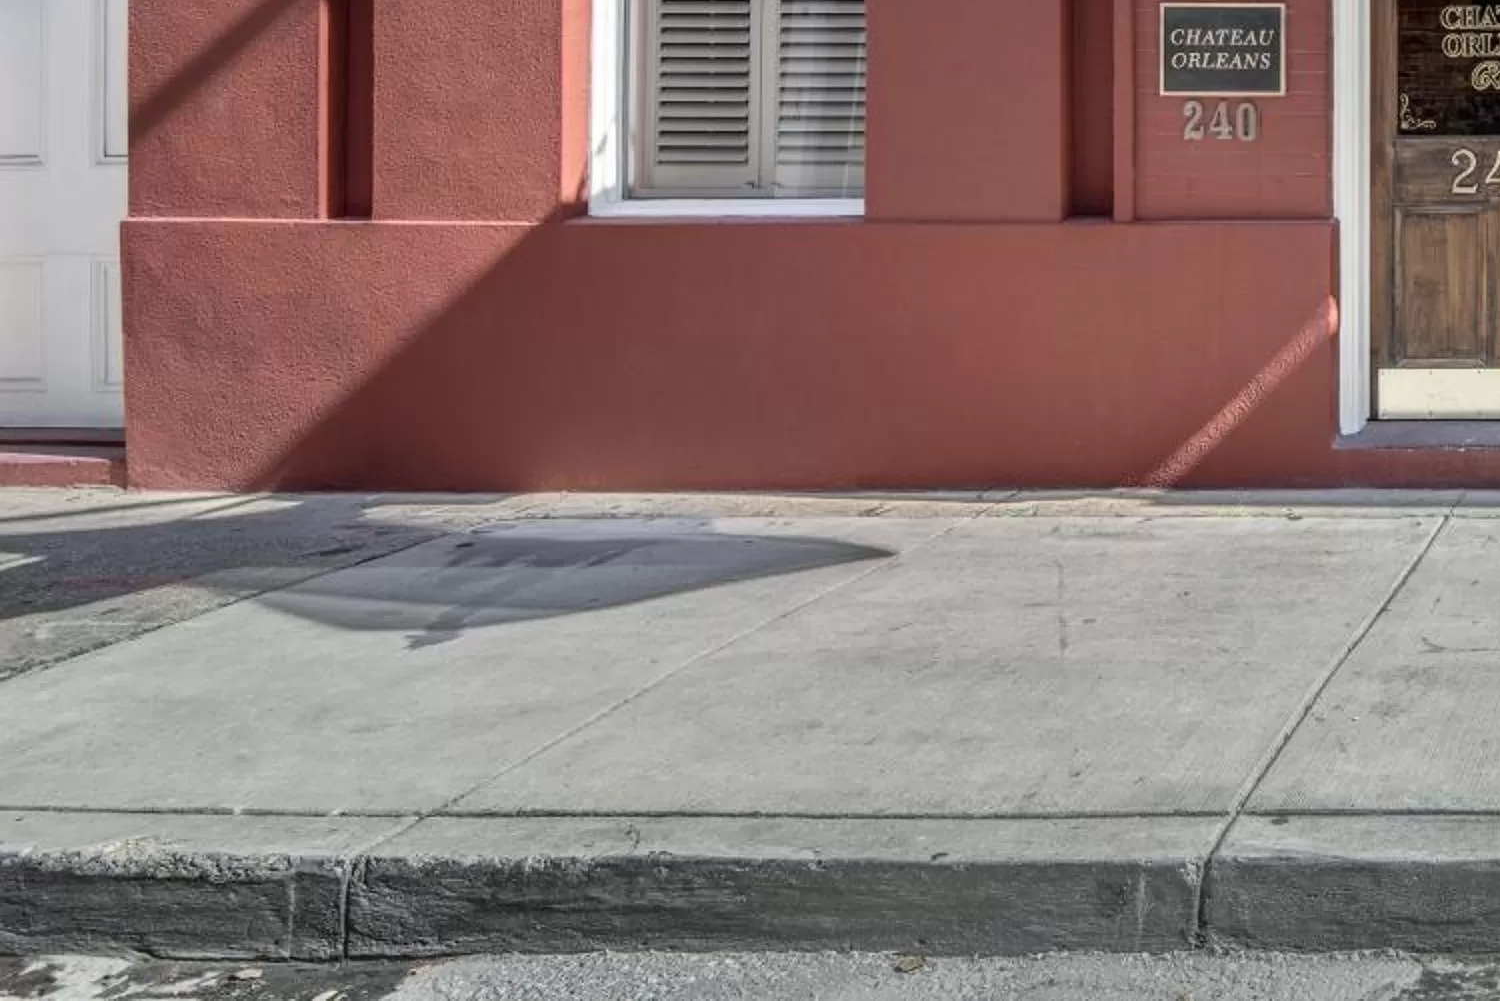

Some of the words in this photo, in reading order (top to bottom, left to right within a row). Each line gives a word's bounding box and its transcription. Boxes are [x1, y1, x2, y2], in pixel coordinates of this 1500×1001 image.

[1170, 28, 1275, 46] CHATEAU
[1170, 52, 1272, 70] ORLEANS
[1183, 100, 1257, 142] 240
